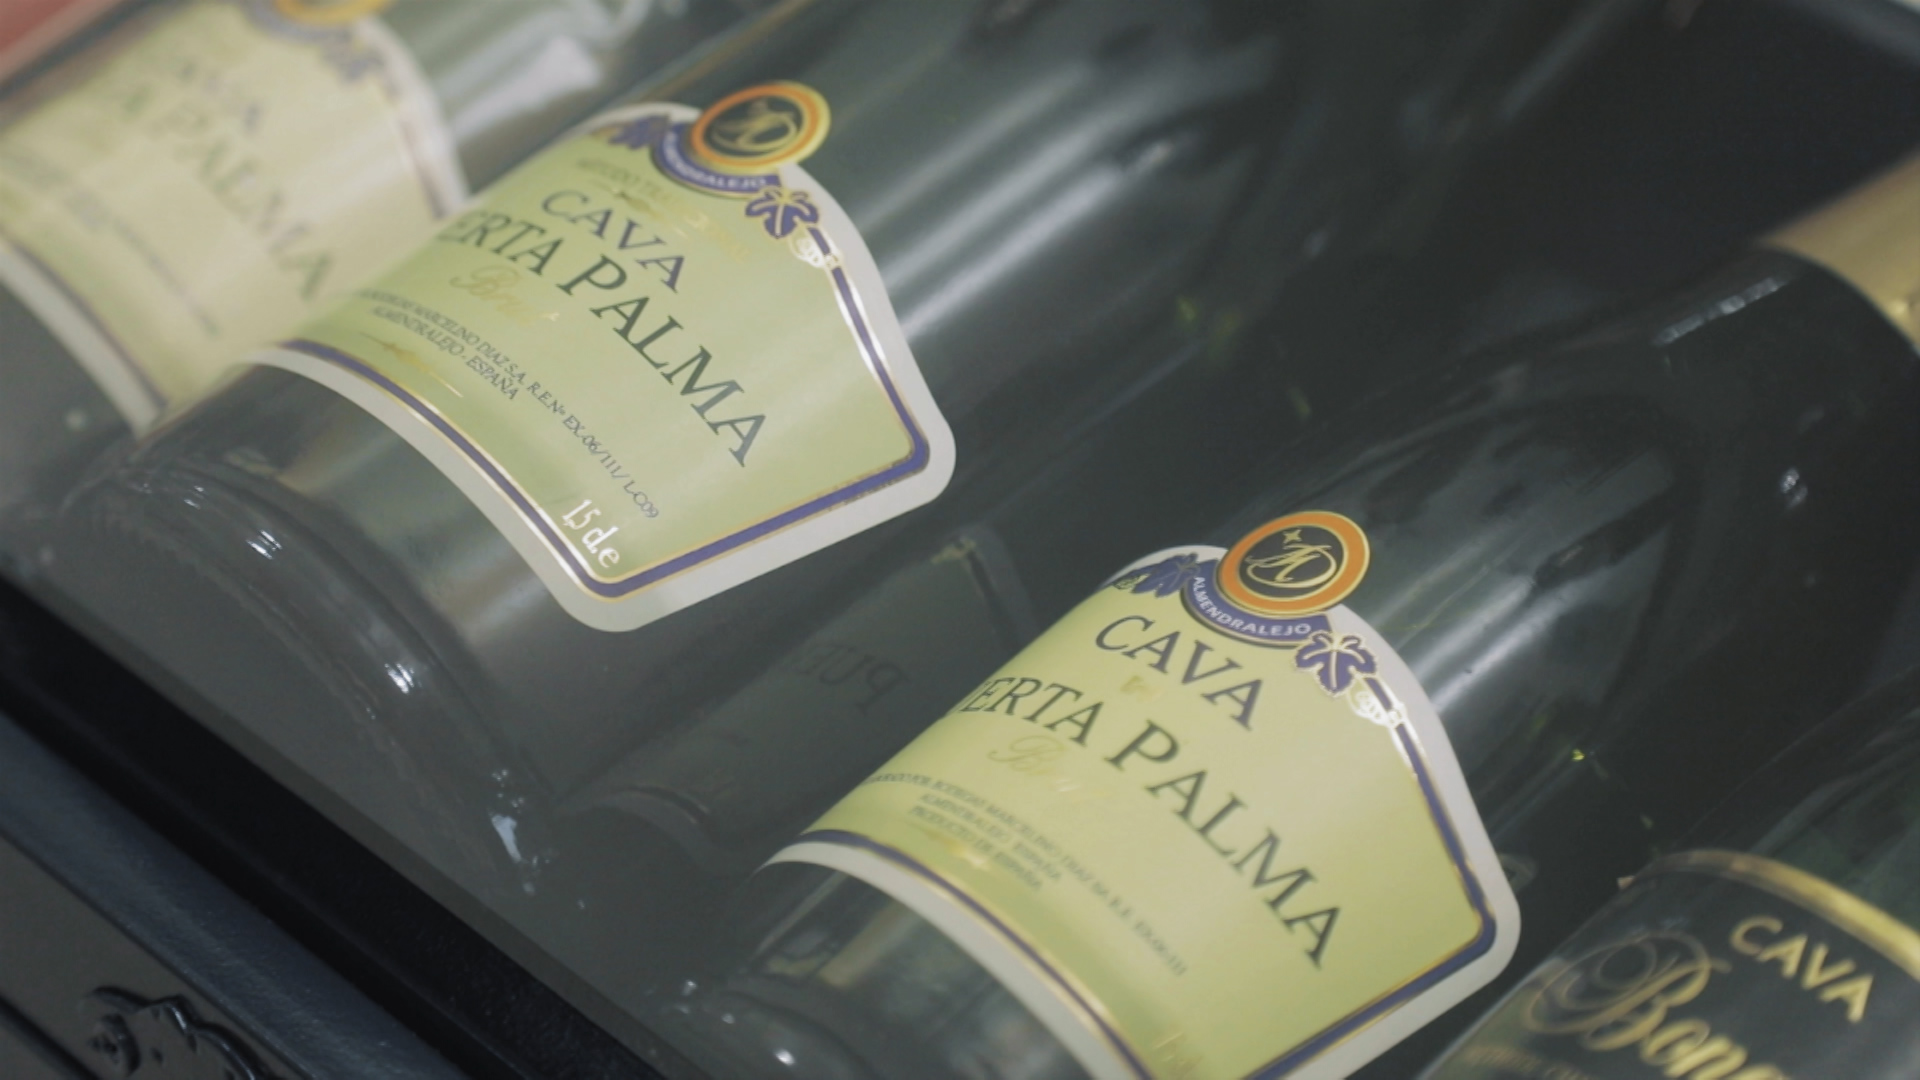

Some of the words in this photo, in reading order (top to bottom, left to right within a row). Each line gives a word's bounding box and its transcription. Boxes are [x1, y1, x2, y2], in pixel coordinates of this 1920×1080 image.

[541, 189, 685, 294] CAVA
[465, 354, 520, 401] ESPAÑA
[556, 253, 767, 468] PALMA
[1192, 575, 1312, 638] ALMENDRALEJO
[1095, 614, 1265, 733] CAVA
[957, 676, 1105, 748] ERTA
[1103, 718, 1347, 972] PALMA
[1729, 915, 1875, 1024] CAVA
